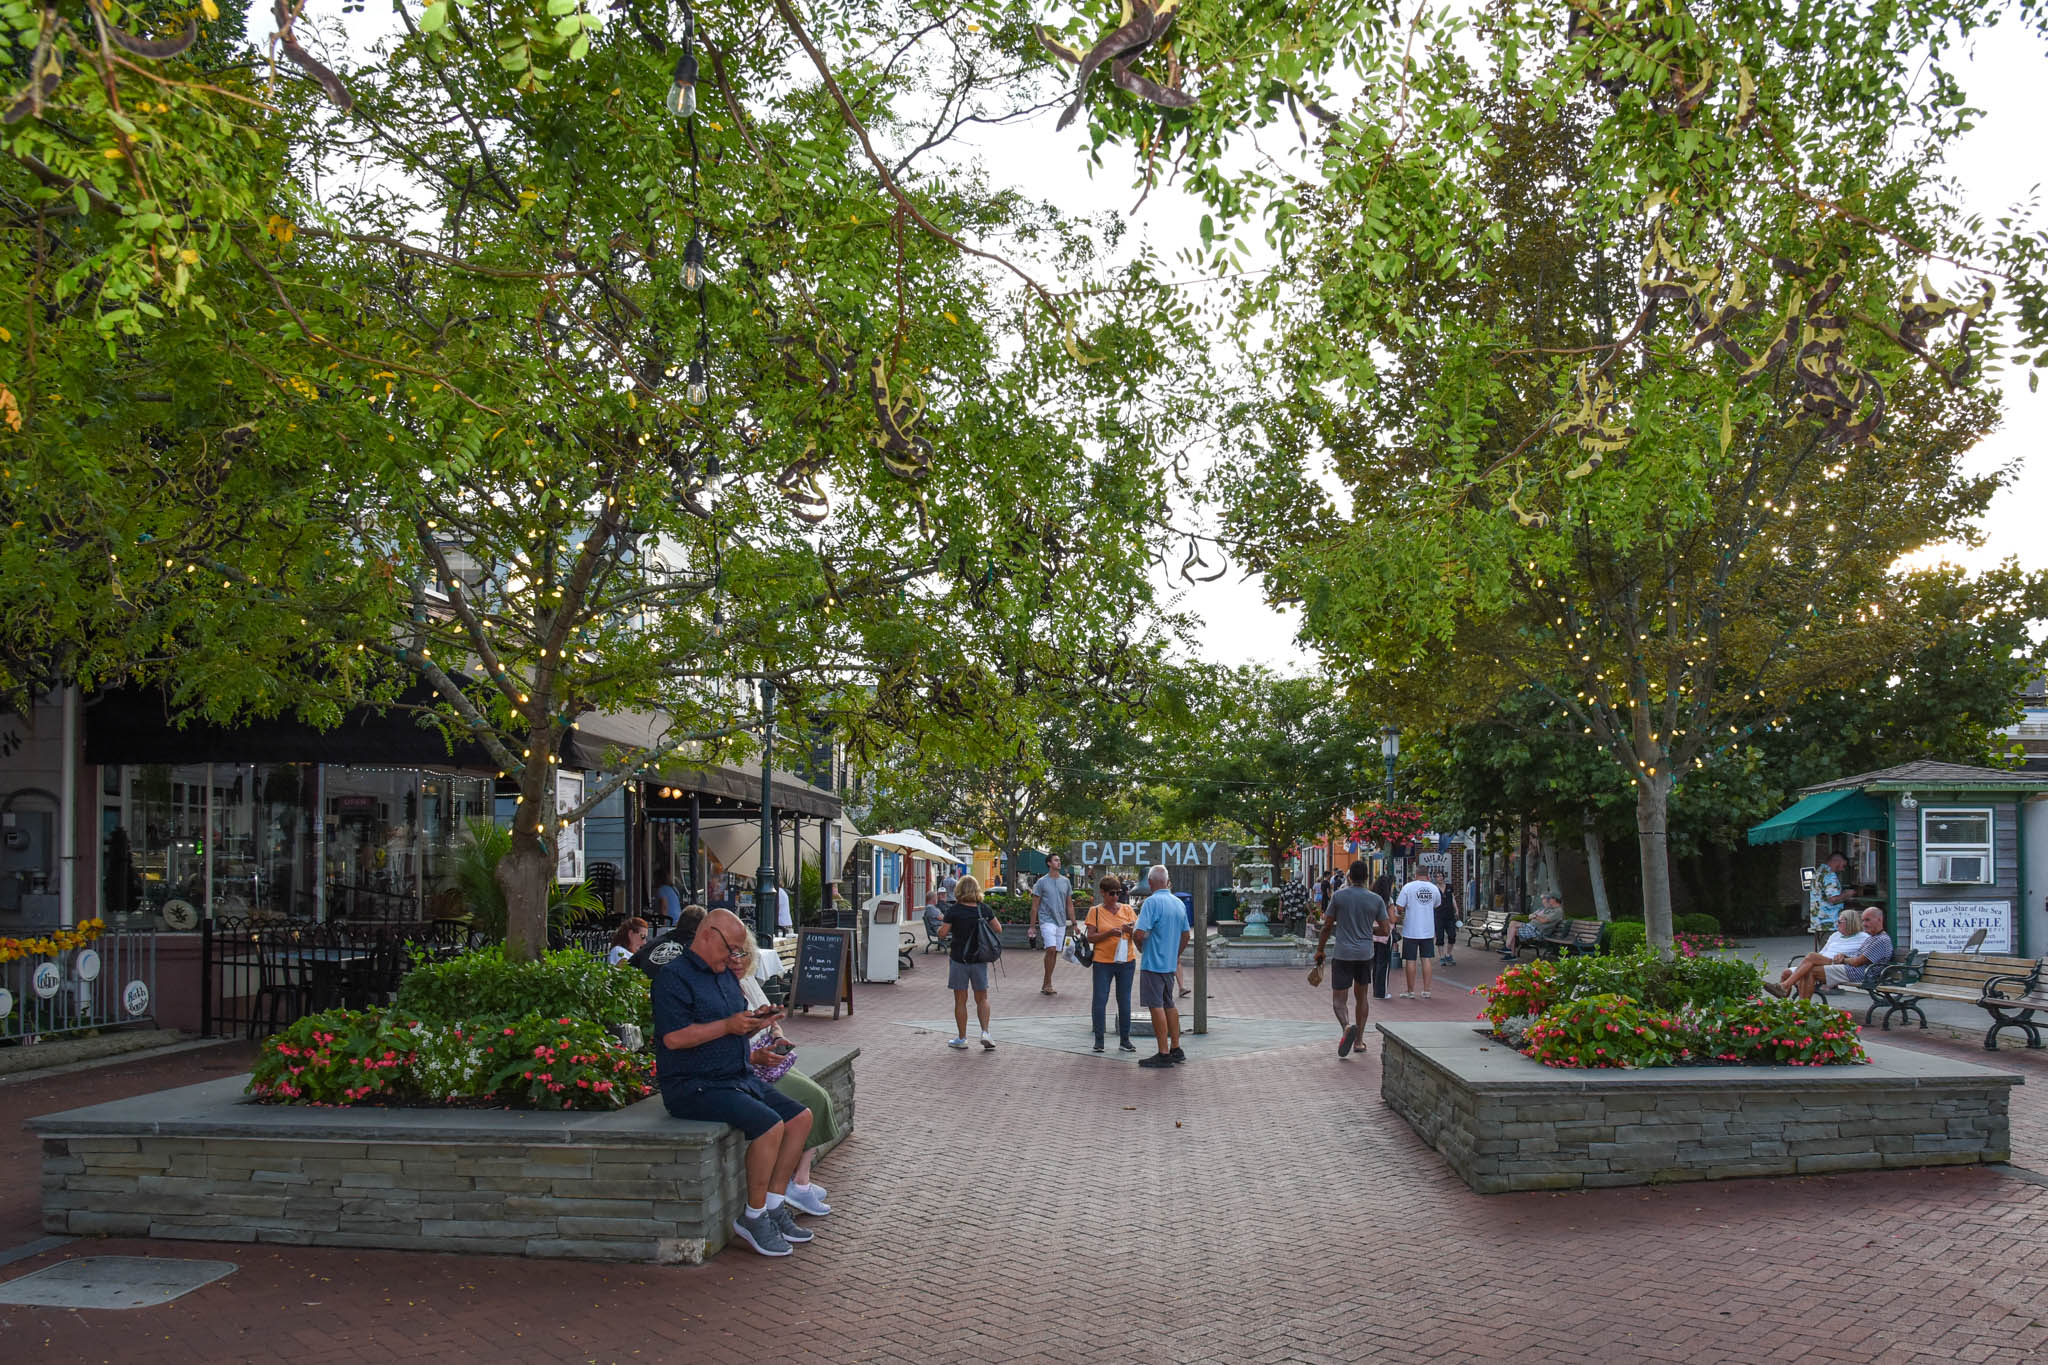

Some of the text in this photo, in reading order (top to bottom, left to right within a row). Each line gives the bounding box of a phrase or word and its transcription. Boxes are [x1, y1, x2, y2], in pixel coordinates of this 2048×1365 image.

[1082, 841, 1217, 864] CAPE MAY
[1918, 908, 1932, 916] Our
[1934, 906, 1952, 914] Lady
[1991, 907, 2002, 915] Sea
[1920, 918, 2001, 928] CAR RAFFLE
